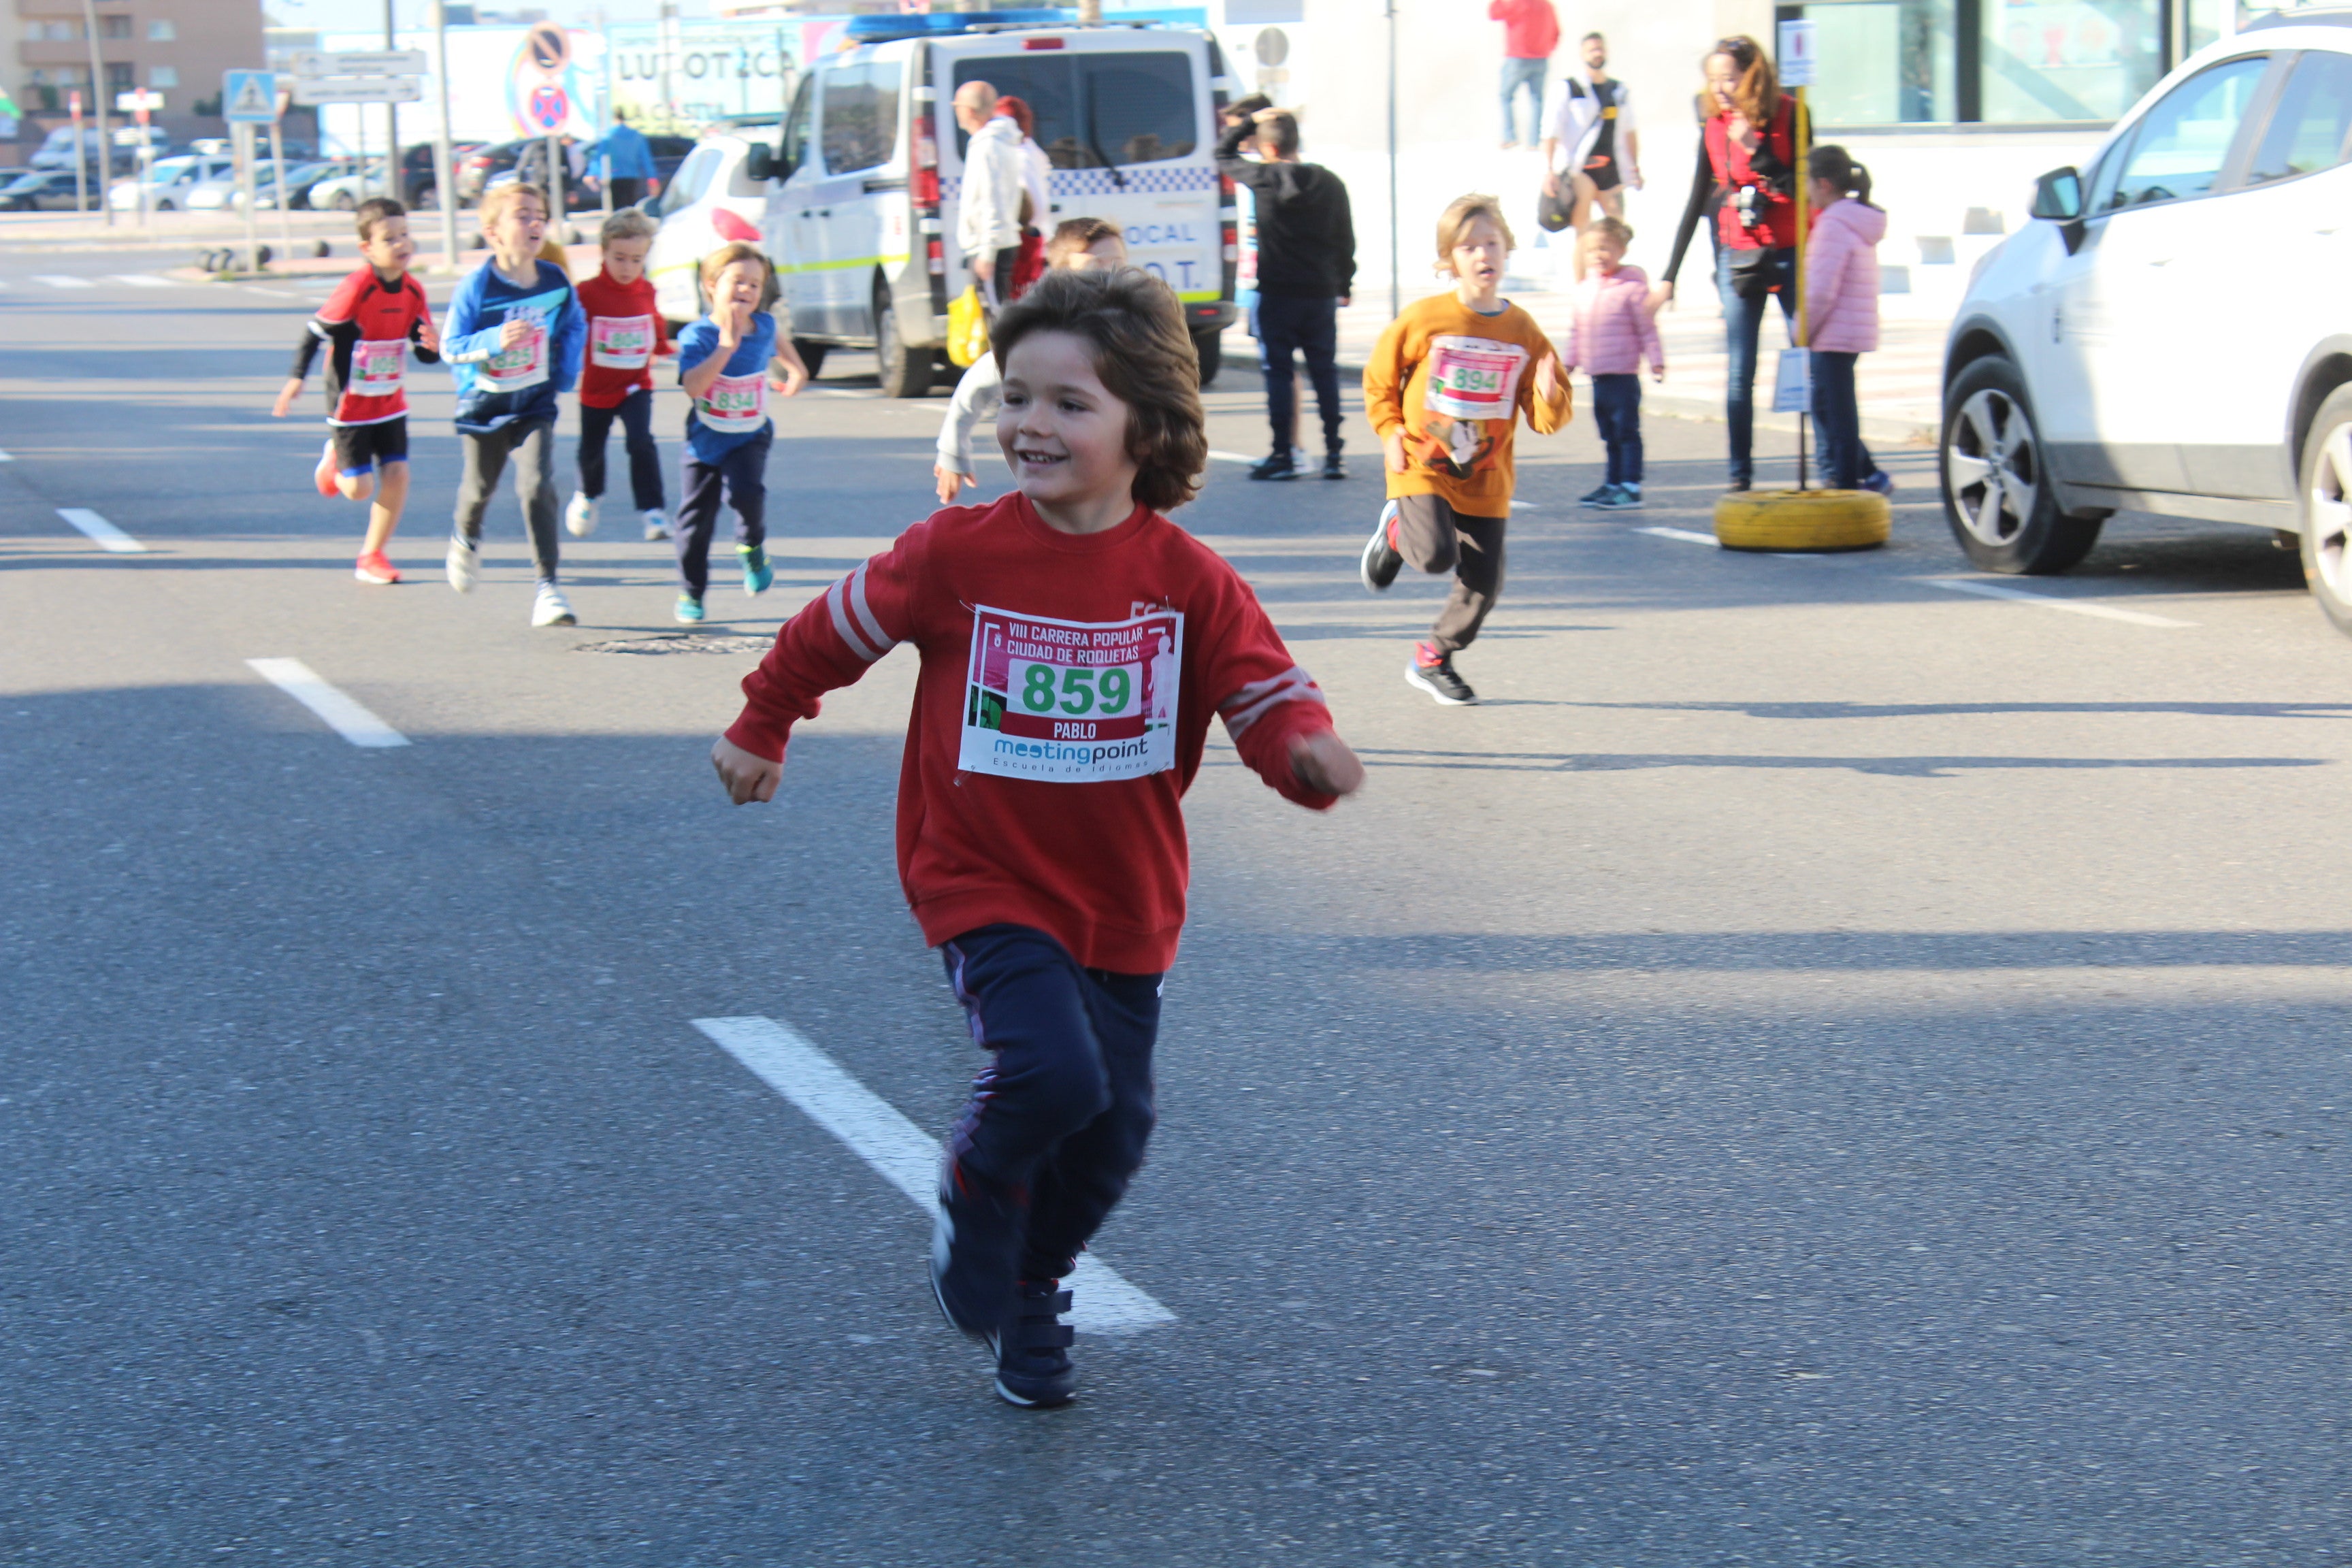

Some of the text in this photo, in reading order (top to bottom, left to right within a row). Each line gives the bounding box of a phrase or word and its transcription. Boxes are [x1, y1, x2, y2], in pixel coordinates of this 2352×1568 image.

[1124, 224, 1196, 245] OCAL
[1454, 368, 1497, 391] 894
[718, 392, 754, 410] 834
[1009, 621, 1143, 647] VIII CARRERA POPULAR
[1007, 640, 1139, 664] CIUDAD DE ROQUETAS
[1022, 664, 1130, 715] 859
[1054, 722, 1096, 740] PABLO
[993, 757, 1054, 773] Escuela
[1065, 765, 1081, 773] de
